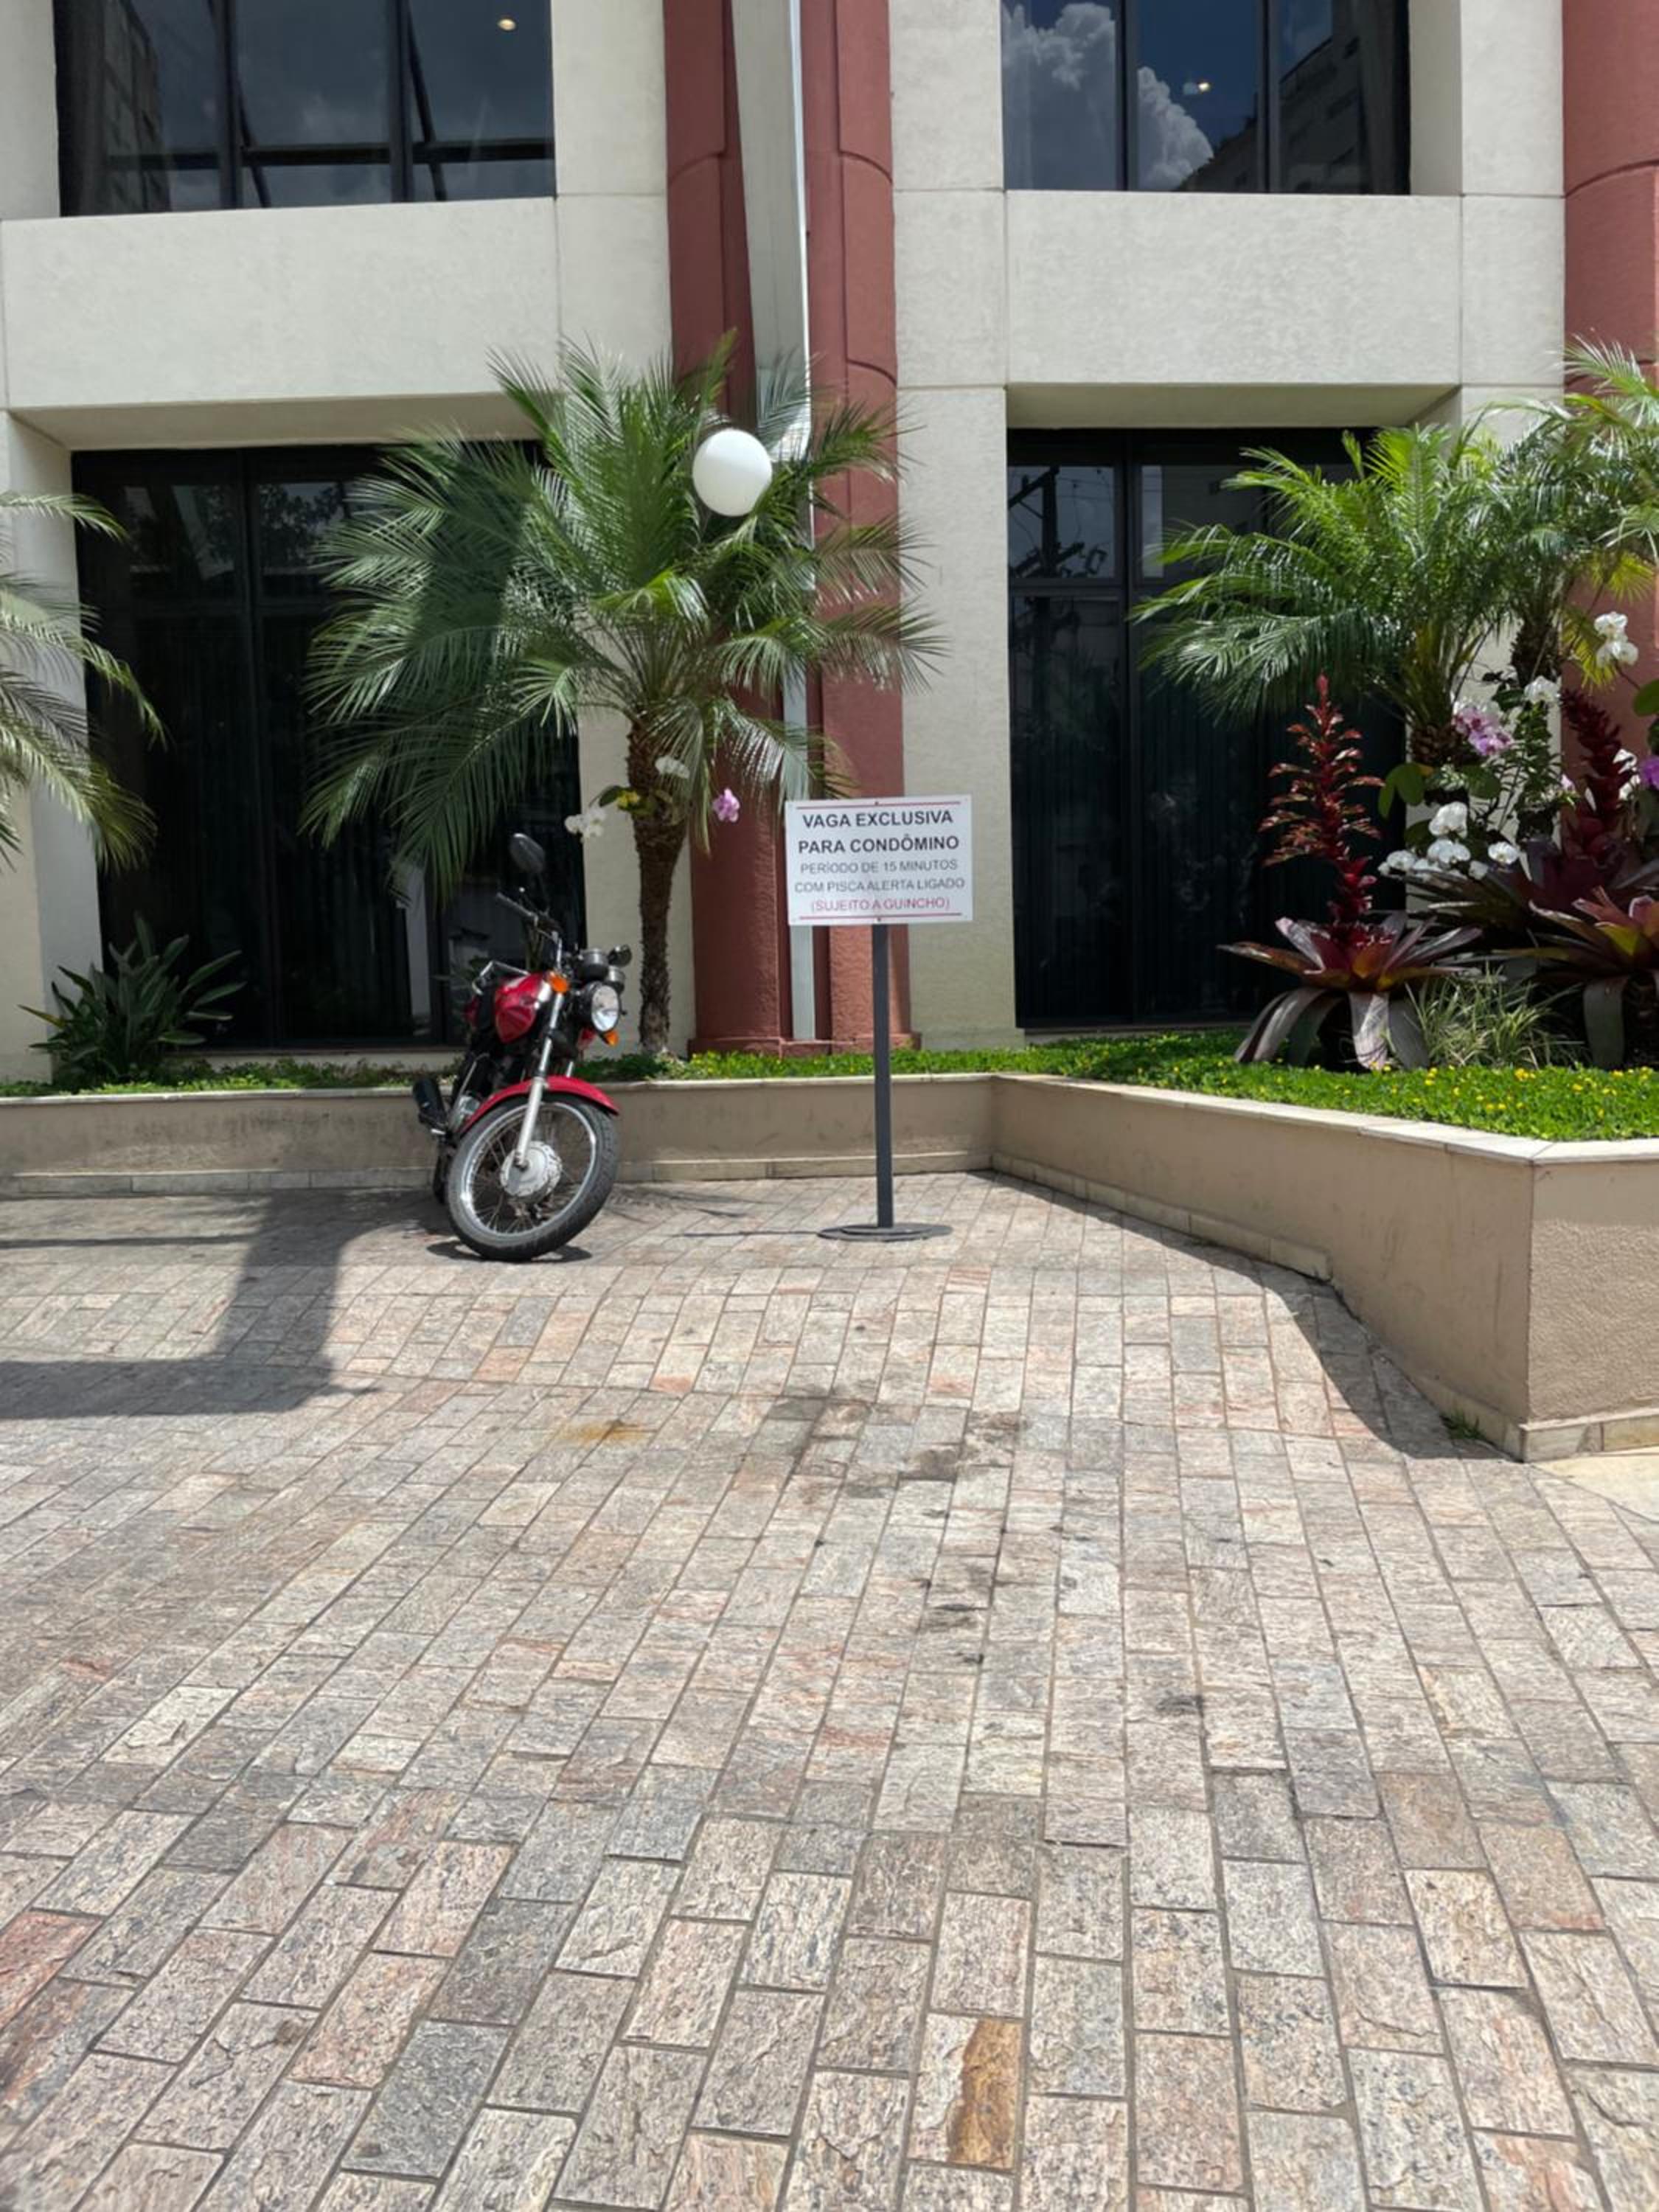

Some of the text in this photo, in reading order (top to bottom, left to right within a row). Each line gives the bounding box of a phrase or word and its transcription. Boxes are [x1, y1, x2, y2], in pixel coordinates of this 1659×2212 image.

[804, 810, 953, 828] VAGA EXCLUSIVA
[799, 835, 959, 853] PARA CONDÔMINO
[861, 861, 879, 872] DE
[885, 863, 897, 872] 15
[900, 859, 958, 871] MINUTOS
[795, 878, 965, 892] COM PISCA ALERTA LIGADO
[812, 897, 950, 912] (SUJEITO A GUINCHO)
